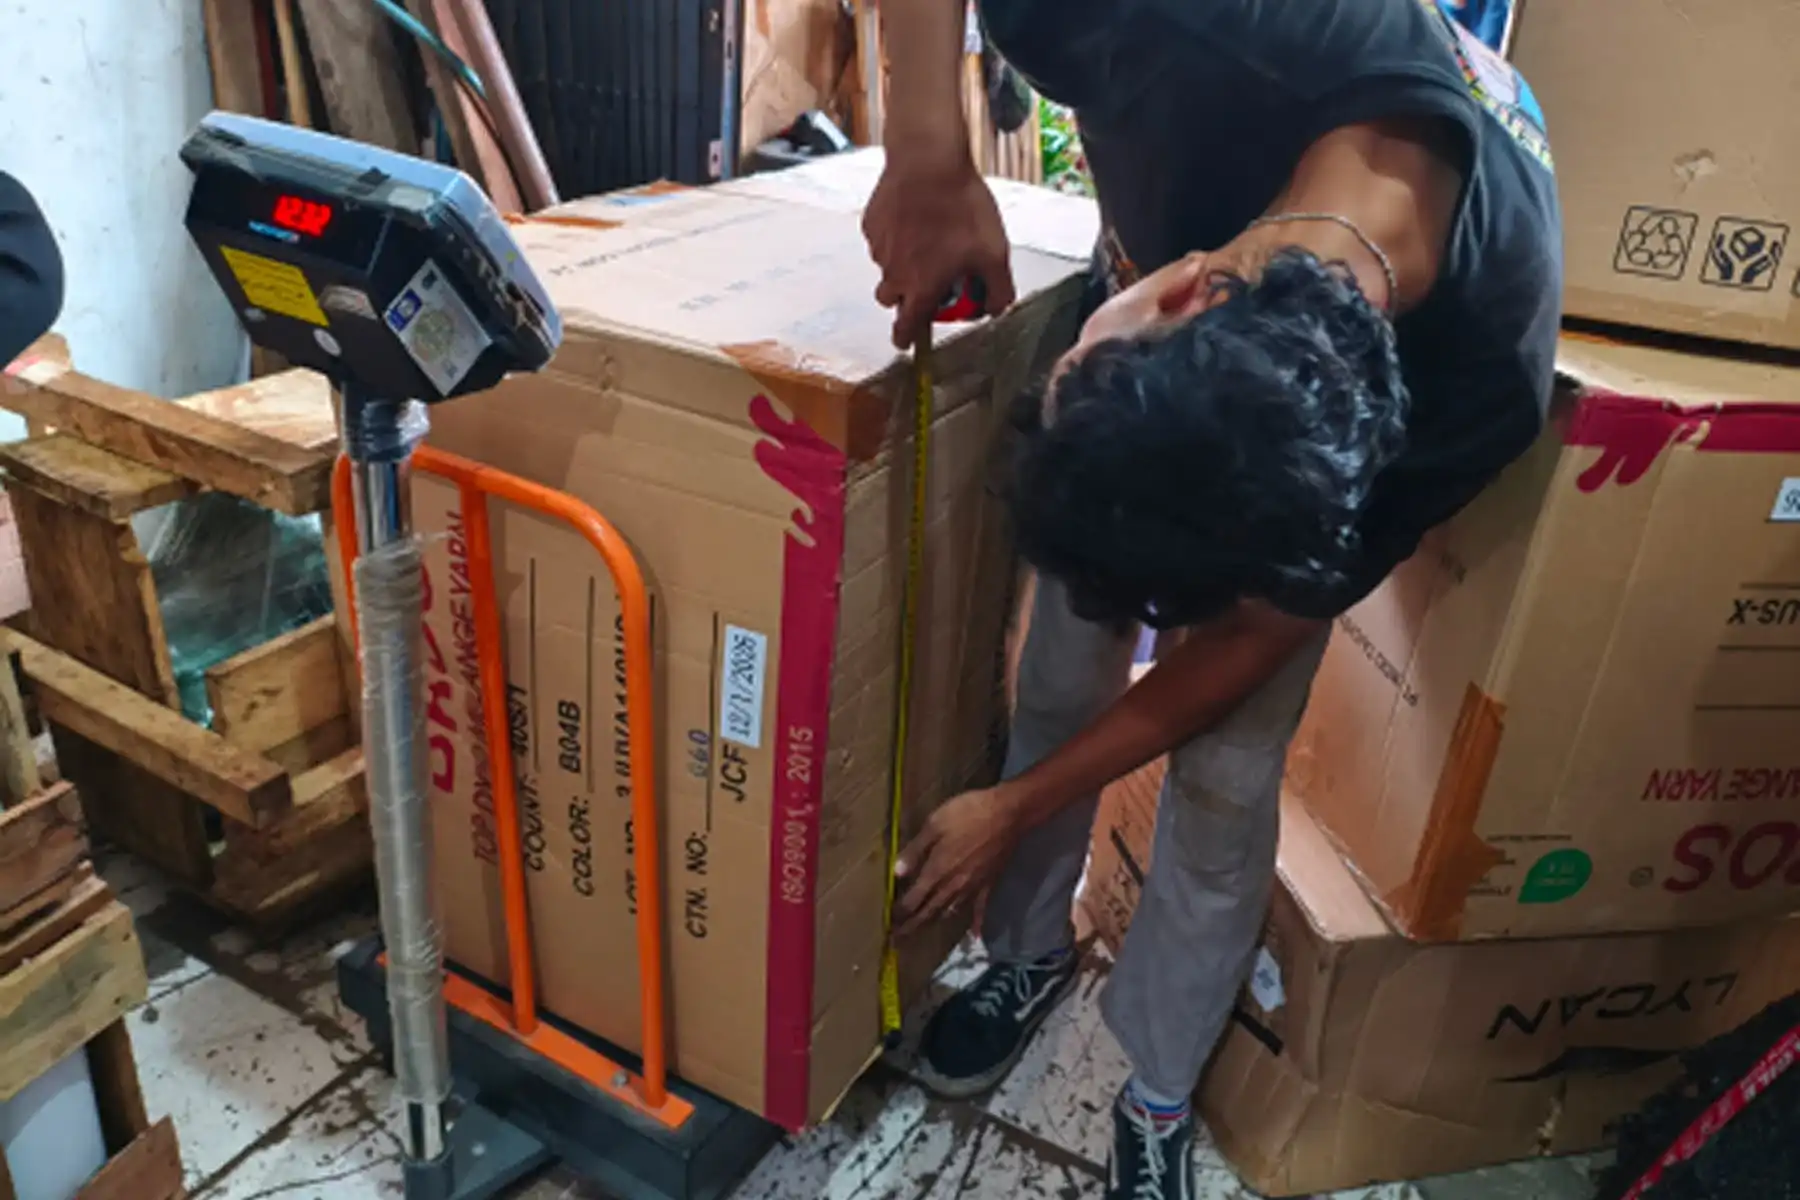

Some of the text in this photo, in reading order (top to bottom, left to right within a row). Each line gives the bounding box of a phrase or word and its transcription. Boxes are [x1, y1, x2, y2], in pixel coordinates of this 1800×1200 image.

[1727, 598, 1800, 625] US-X
[720, 744, 747, 803] JCF
[785, 724, 814, 785] 2015
[557, 700, 594, 898] COLOR: B04B
[1641, 767, 1722, 802] YARN
[686, 831, 708, 876] NO:
[1663, 819, 1800, 896] OS
[685, 888, 707, 940] CTN.
[1486, 973, 1739, 1041] LYCAN
